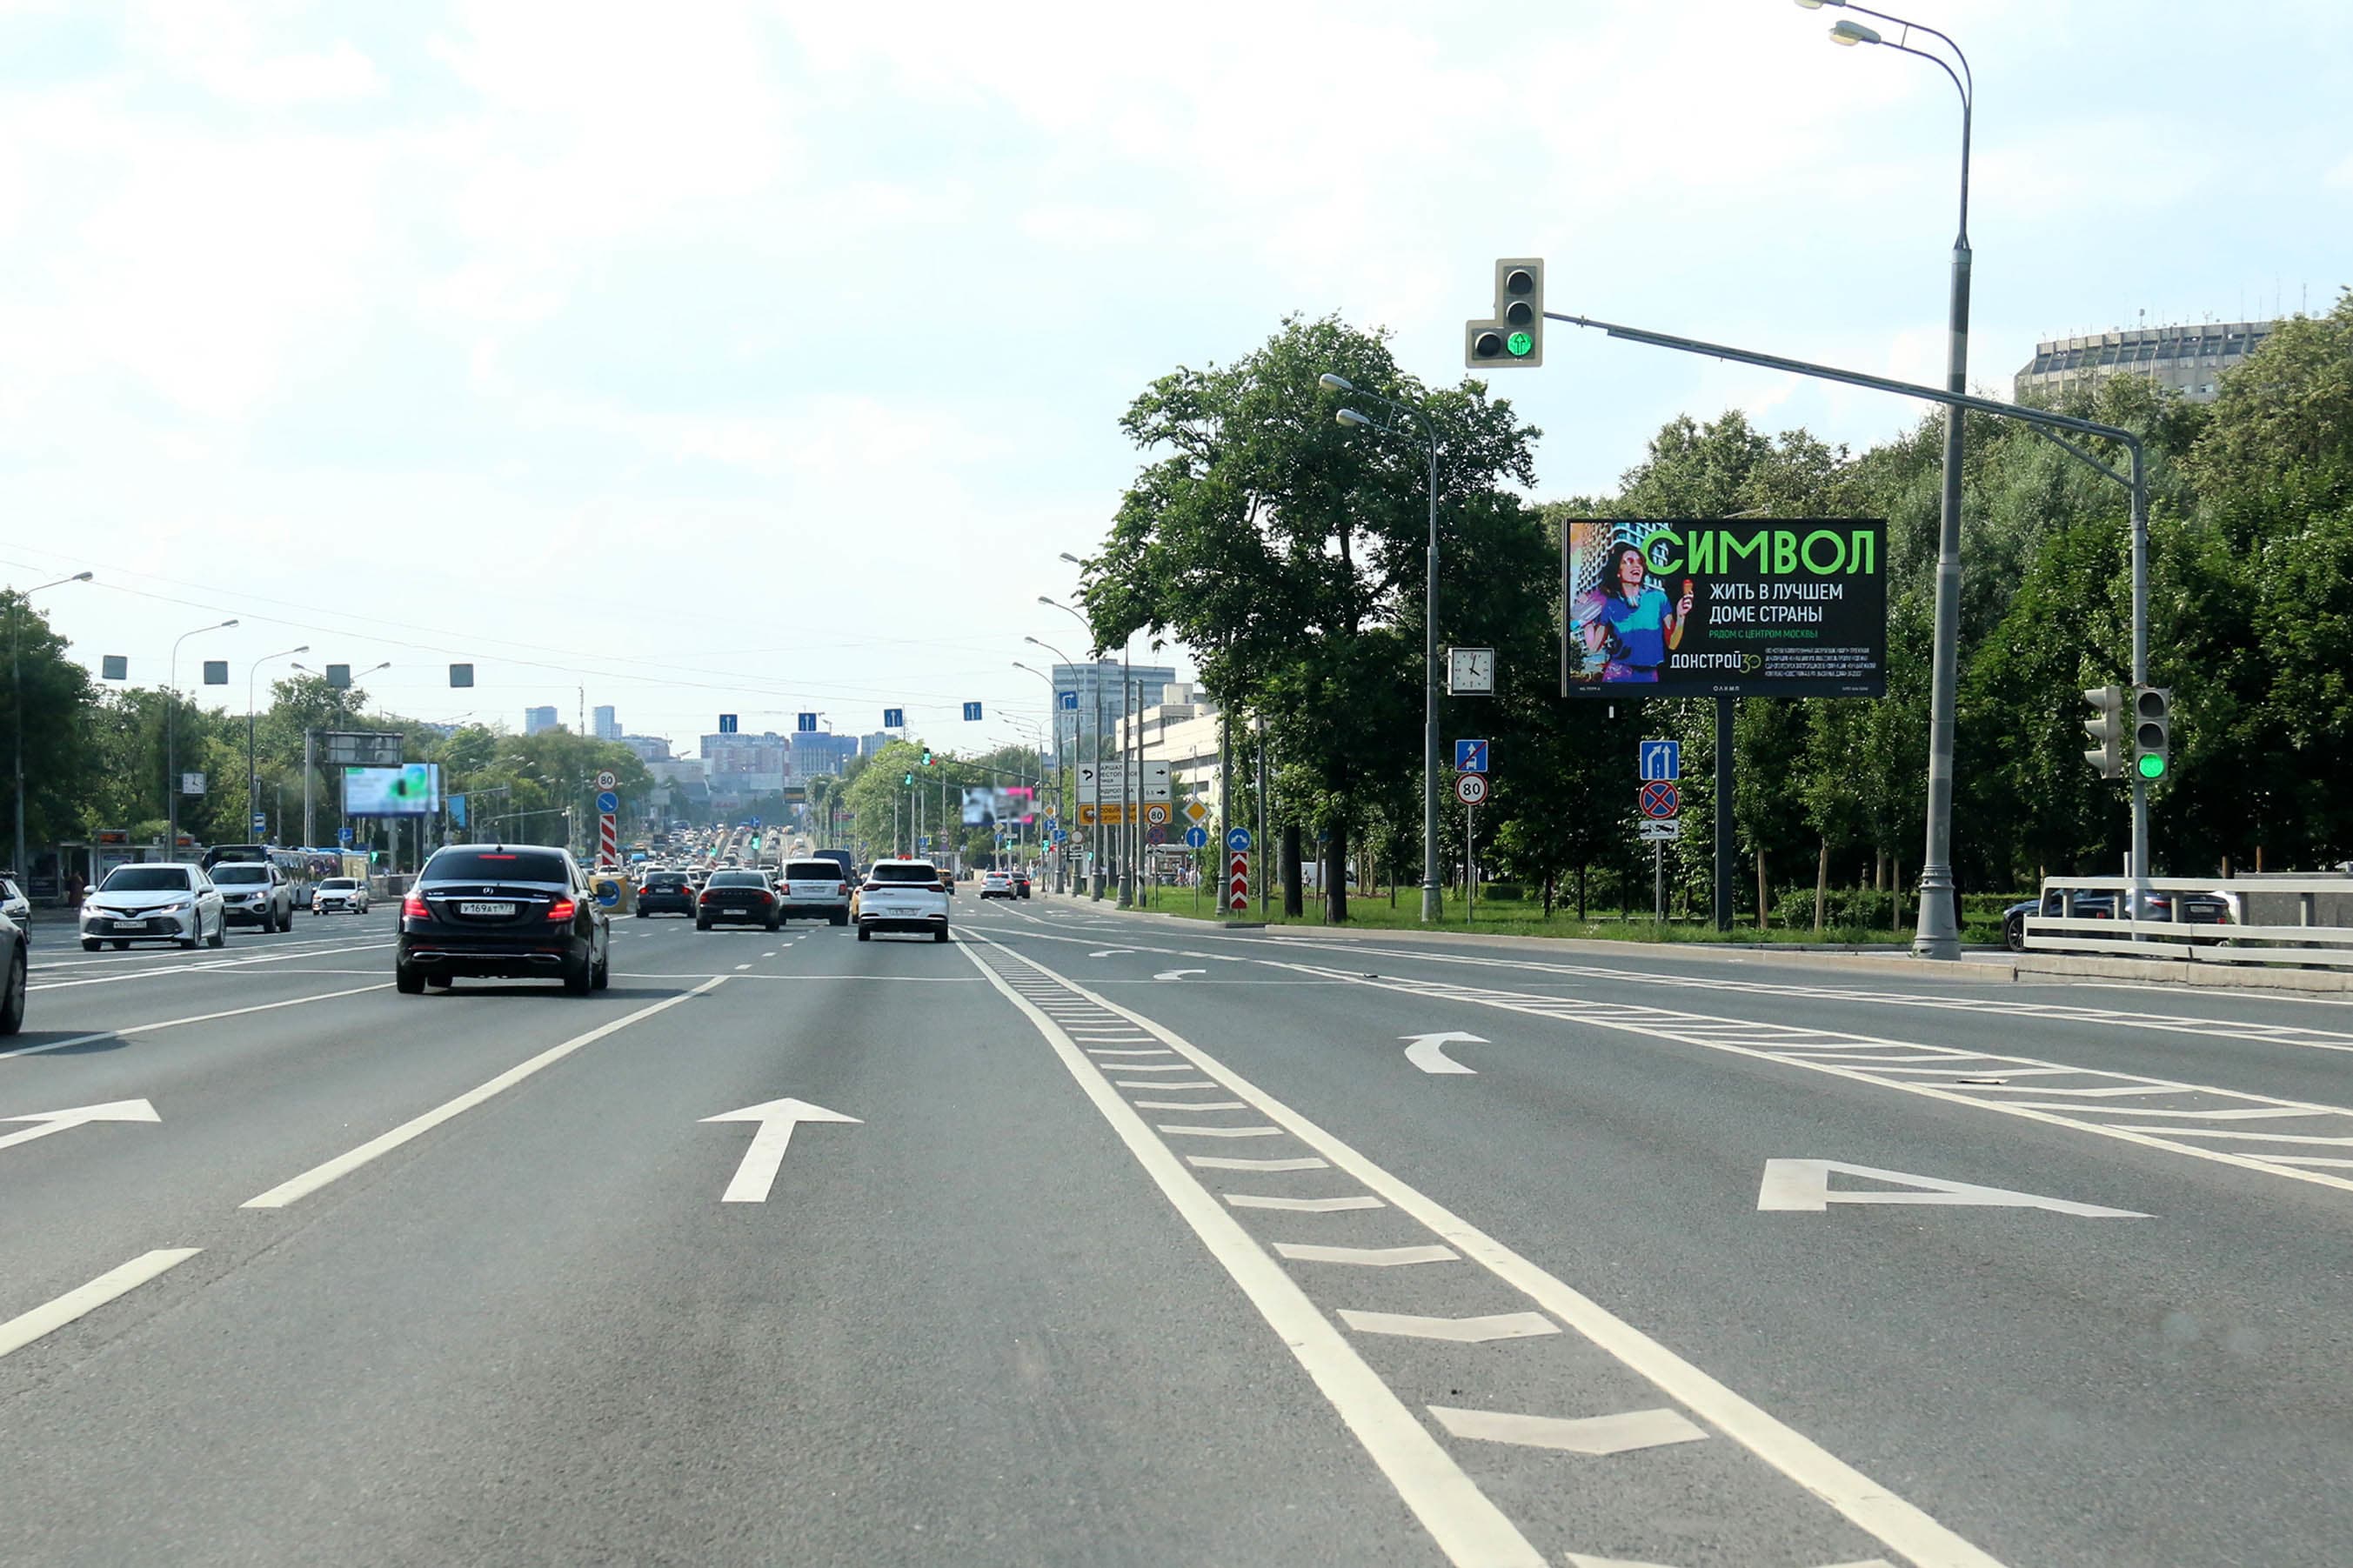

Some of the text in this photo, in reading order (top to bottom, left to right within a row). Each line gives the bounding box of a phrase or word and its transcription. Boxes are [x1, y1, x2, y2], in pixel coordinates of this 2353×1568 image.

[1641, 529, 1874, 575] СИМВОЛ
[1709, 584, 1843, 600] ЖИТЬ В ЛУЧШЕМ
[1709, 606, 1822, 624] ДОМЕ СТРАНЫ
[1708, 630, 1818, 639] РЯДОМ С ЦЕНТРОМ МОСКВЫ
[1670, 651, 1741, 670] ДОНСТРОЙ
[600, 776, 613, 785] 80
[1462, 783, 1481, 796] 80
[1151, 811, 1162, 820] 80
